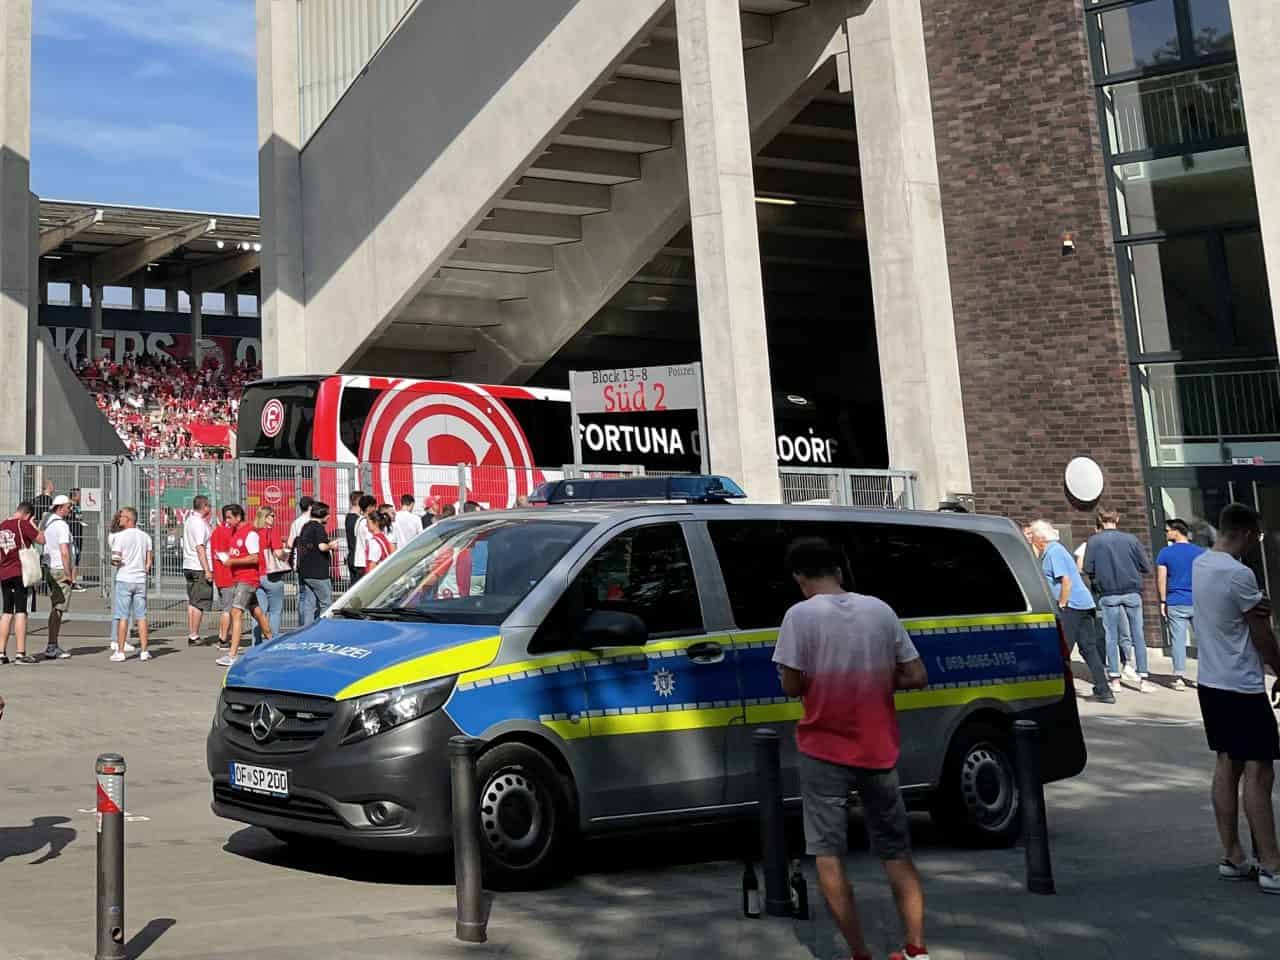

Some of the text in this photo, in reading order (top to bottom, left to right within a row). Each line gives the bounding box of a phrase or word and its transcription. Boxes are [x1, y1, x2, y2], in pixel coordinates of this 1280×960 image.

[591, 368, 648, 384] Block 13-8
[603, 380, 668, 413] Süd 2
[253, 768, 265, 788] SP
[267, 771, 287, 791] 200
